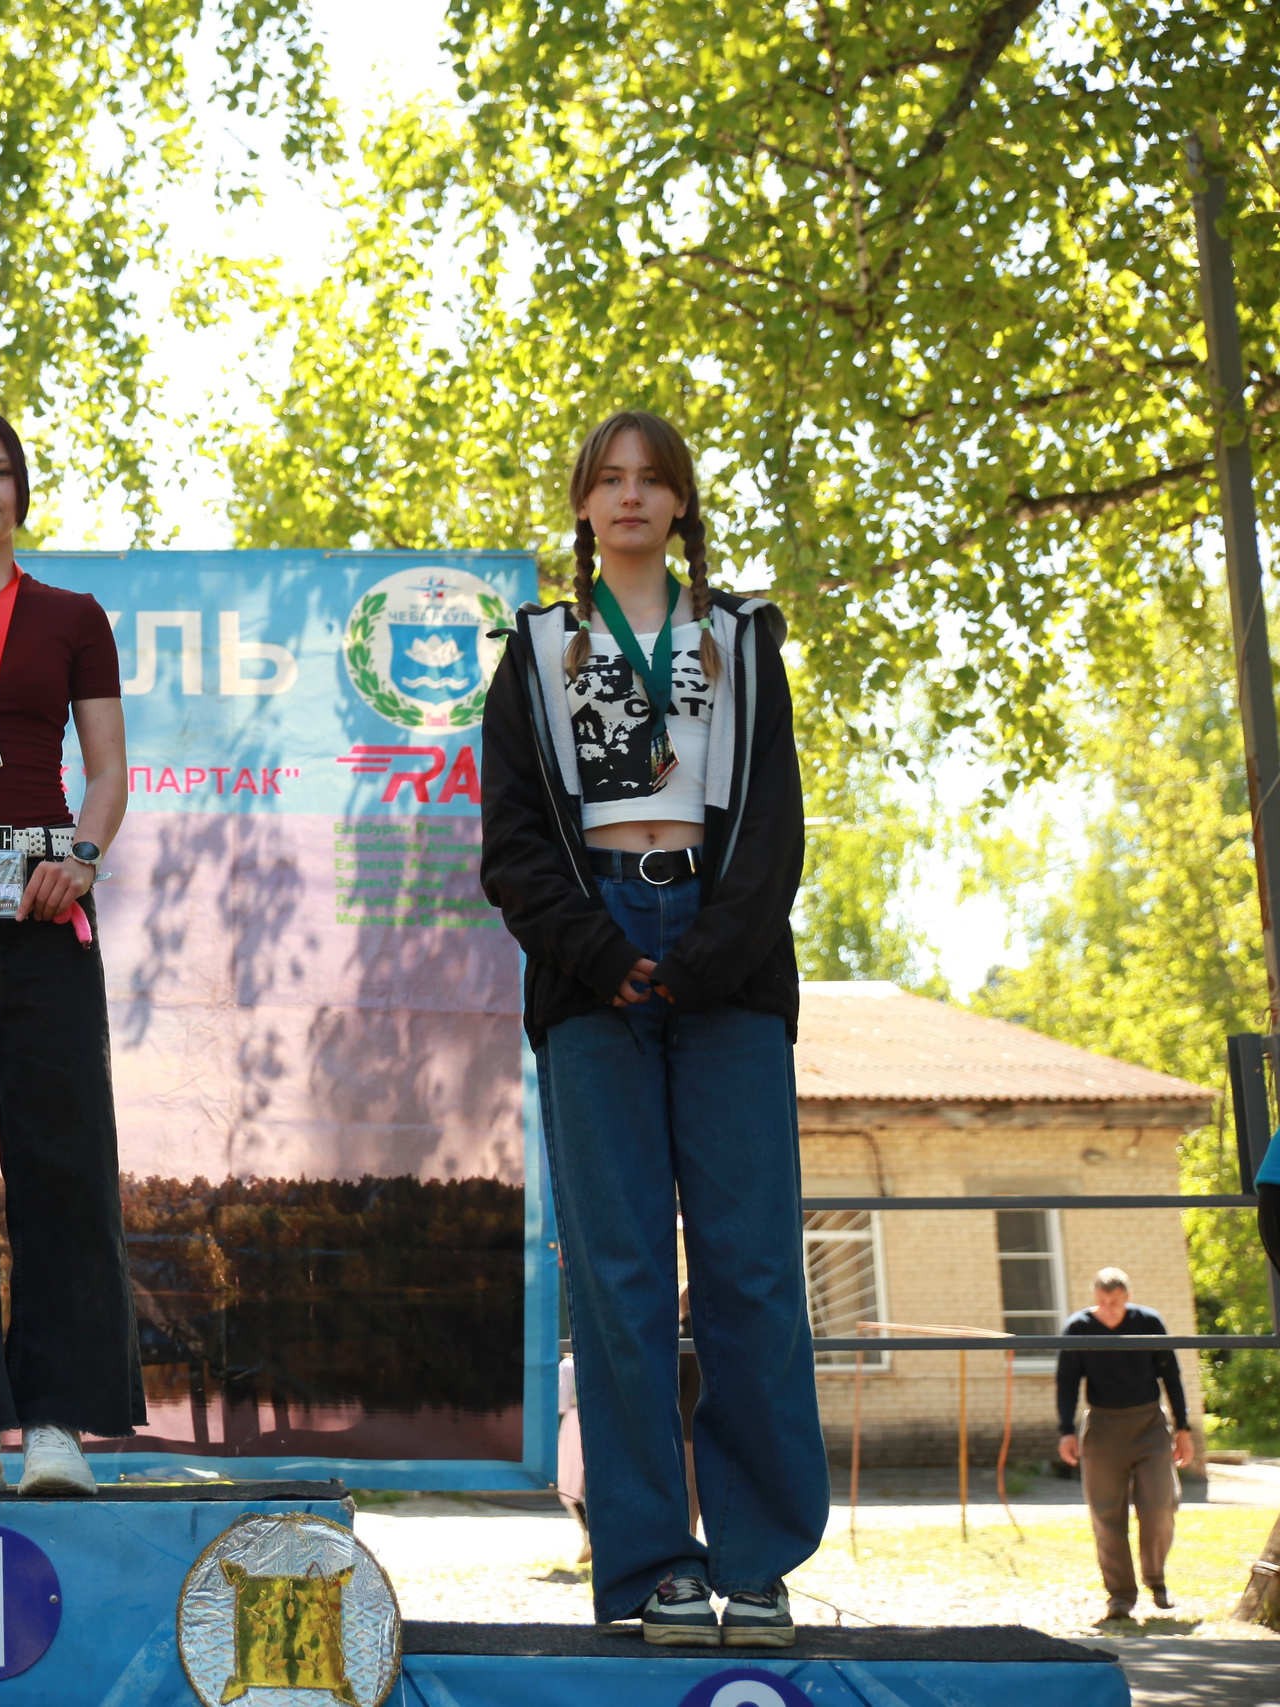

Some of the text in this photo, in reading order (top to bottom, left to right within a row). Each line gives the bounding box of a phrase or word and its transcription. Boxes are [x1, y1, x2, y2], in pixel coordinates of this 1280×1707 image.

[333, 821, 454, 836] Байбурин Раис
[409, 858, 468, 874] Андрей
[334, 876, 444, 891] Зорин Сергей
